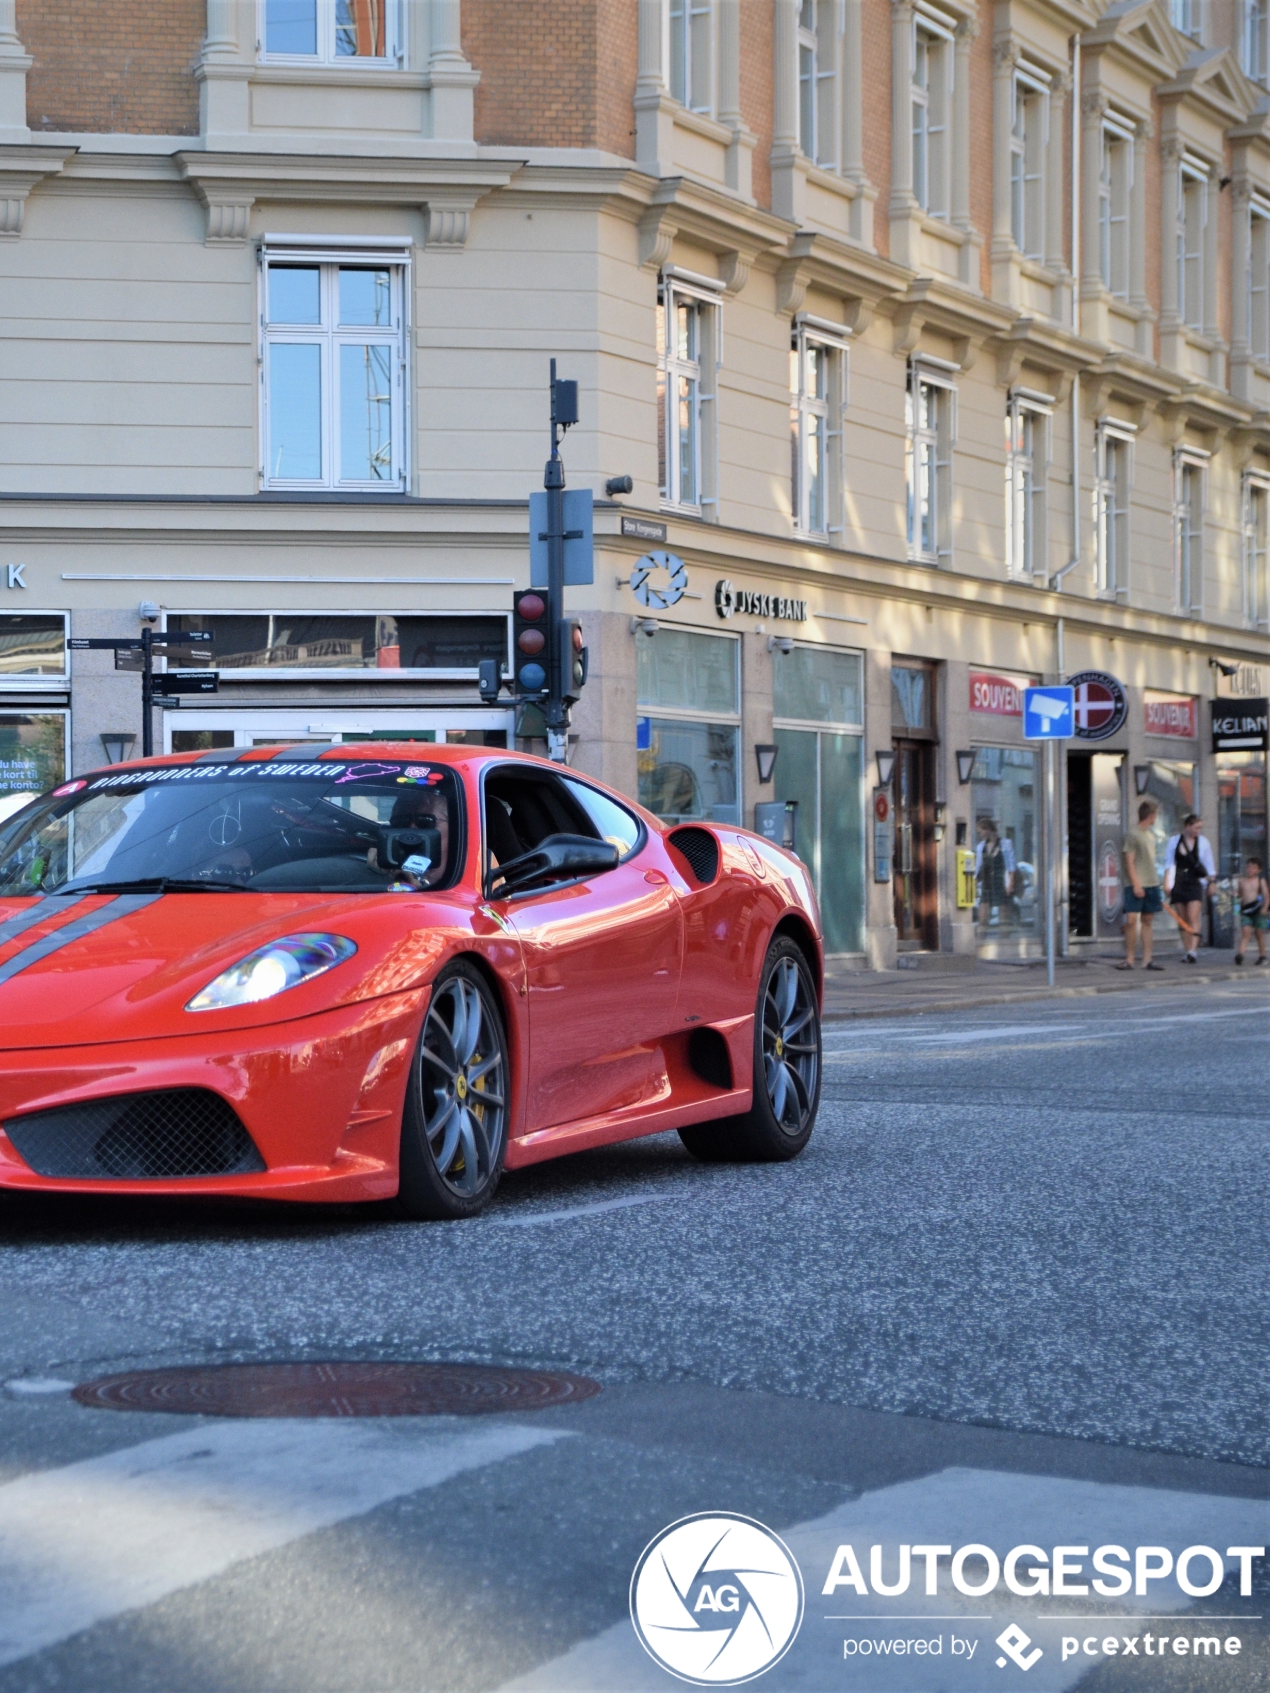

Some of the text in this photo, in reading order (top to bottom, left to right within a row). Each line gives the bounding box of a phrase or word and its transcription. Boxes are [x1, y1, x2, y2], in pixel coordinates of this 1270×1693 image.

[738, 591, 808, 621] JYSKE BANK
[11, 760, 36, 769] have
[3, 770, 25, 779] kort
[27, 770, 38, 779] til
[261, 764, 346, 776] SWEDEN
[10, 781, 44, 789] konto?
